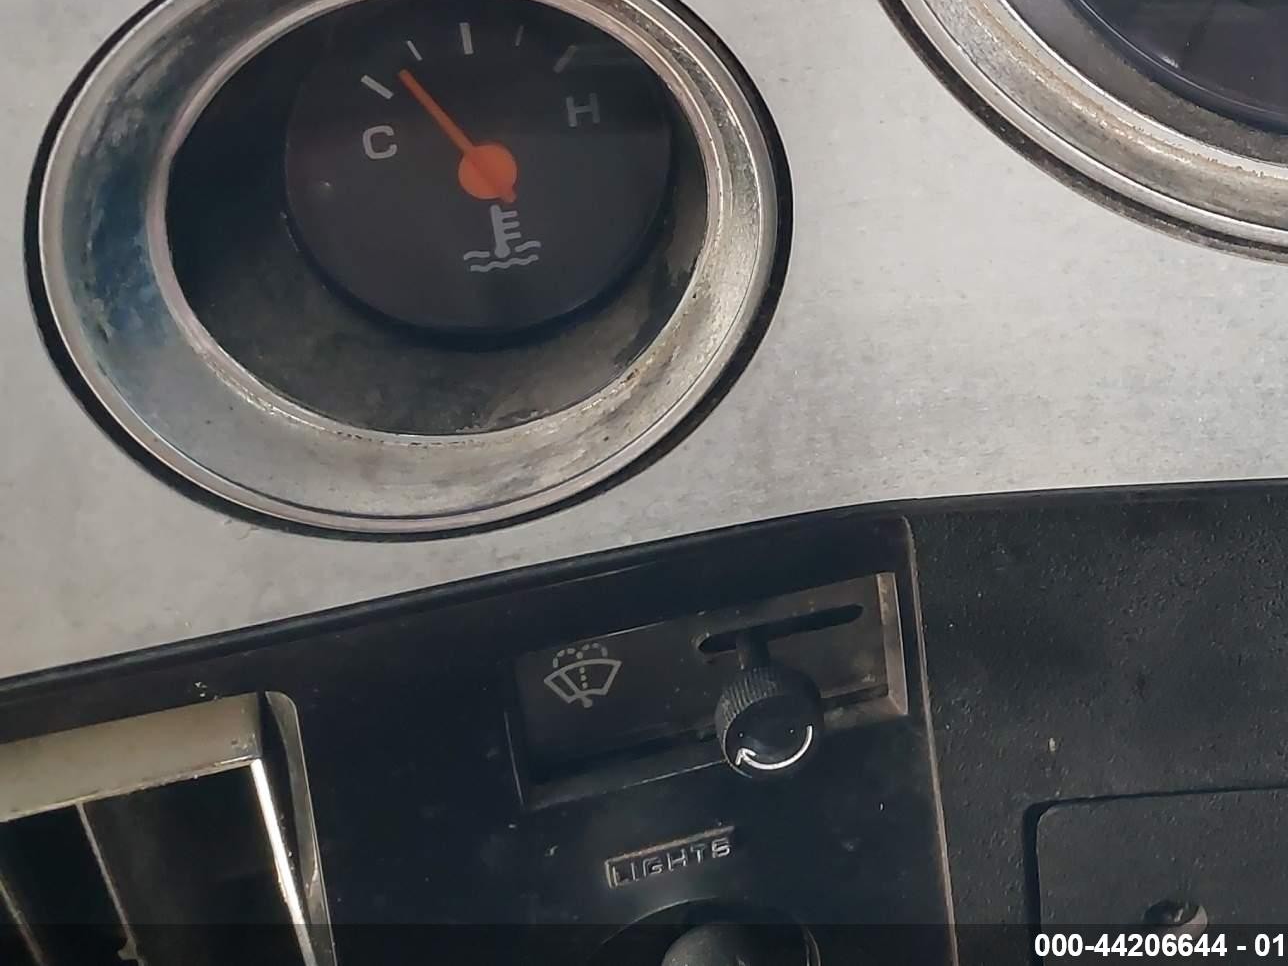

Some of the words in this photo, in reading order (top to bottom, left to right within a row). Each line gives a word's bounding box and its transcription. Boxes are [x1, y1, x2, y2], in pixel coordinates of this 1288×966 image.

[565, 92, 601, 128] H
[362, 125, 399, 160] C
[610, 836, 733, 887] LIGHTS
